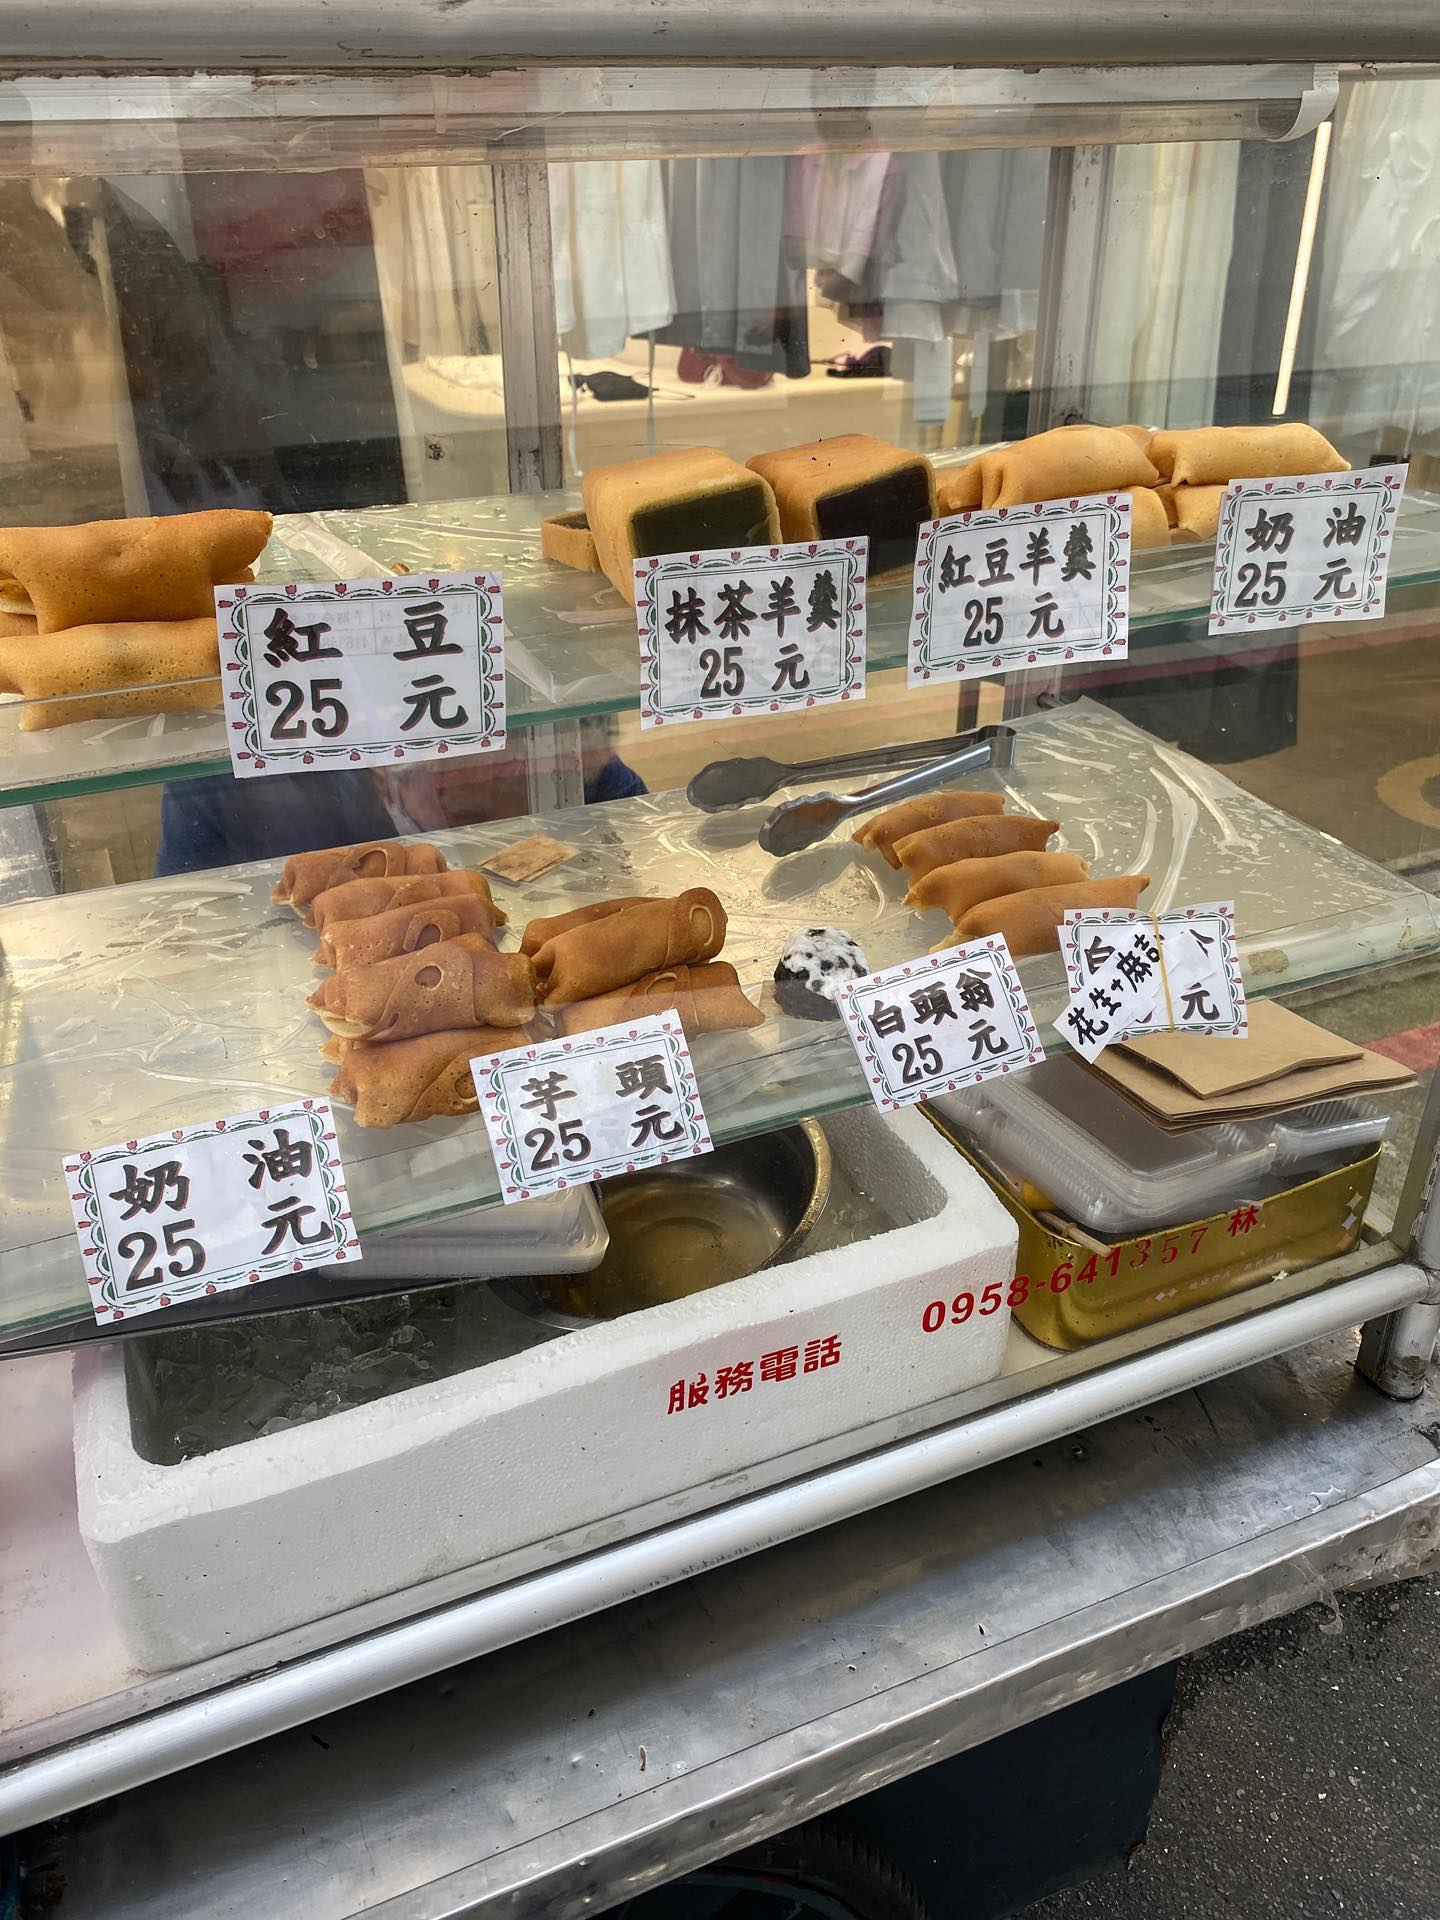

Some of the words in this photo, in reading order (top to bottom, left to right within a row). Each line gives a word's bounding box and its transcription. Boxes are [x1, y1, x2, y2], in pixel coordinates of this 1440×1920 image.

[938, 521, 1096, 594] 紅豆羊羹
[664, 569, 842, 644] 抹茶羊羹
[265, 678, 349, 740] 25
[400, 674, 469, 732] 元
[868, 968, 995, 1039] 白頭翁
[117, 1218, 206, 1291] 25
[261, 1195, 335, 1255] 元
[667, 1334, 842, 1414] 服務電話
[921, 1226, 1208, 1333] 0958-641357
[1227, 1204, 1261, 1239] 林
